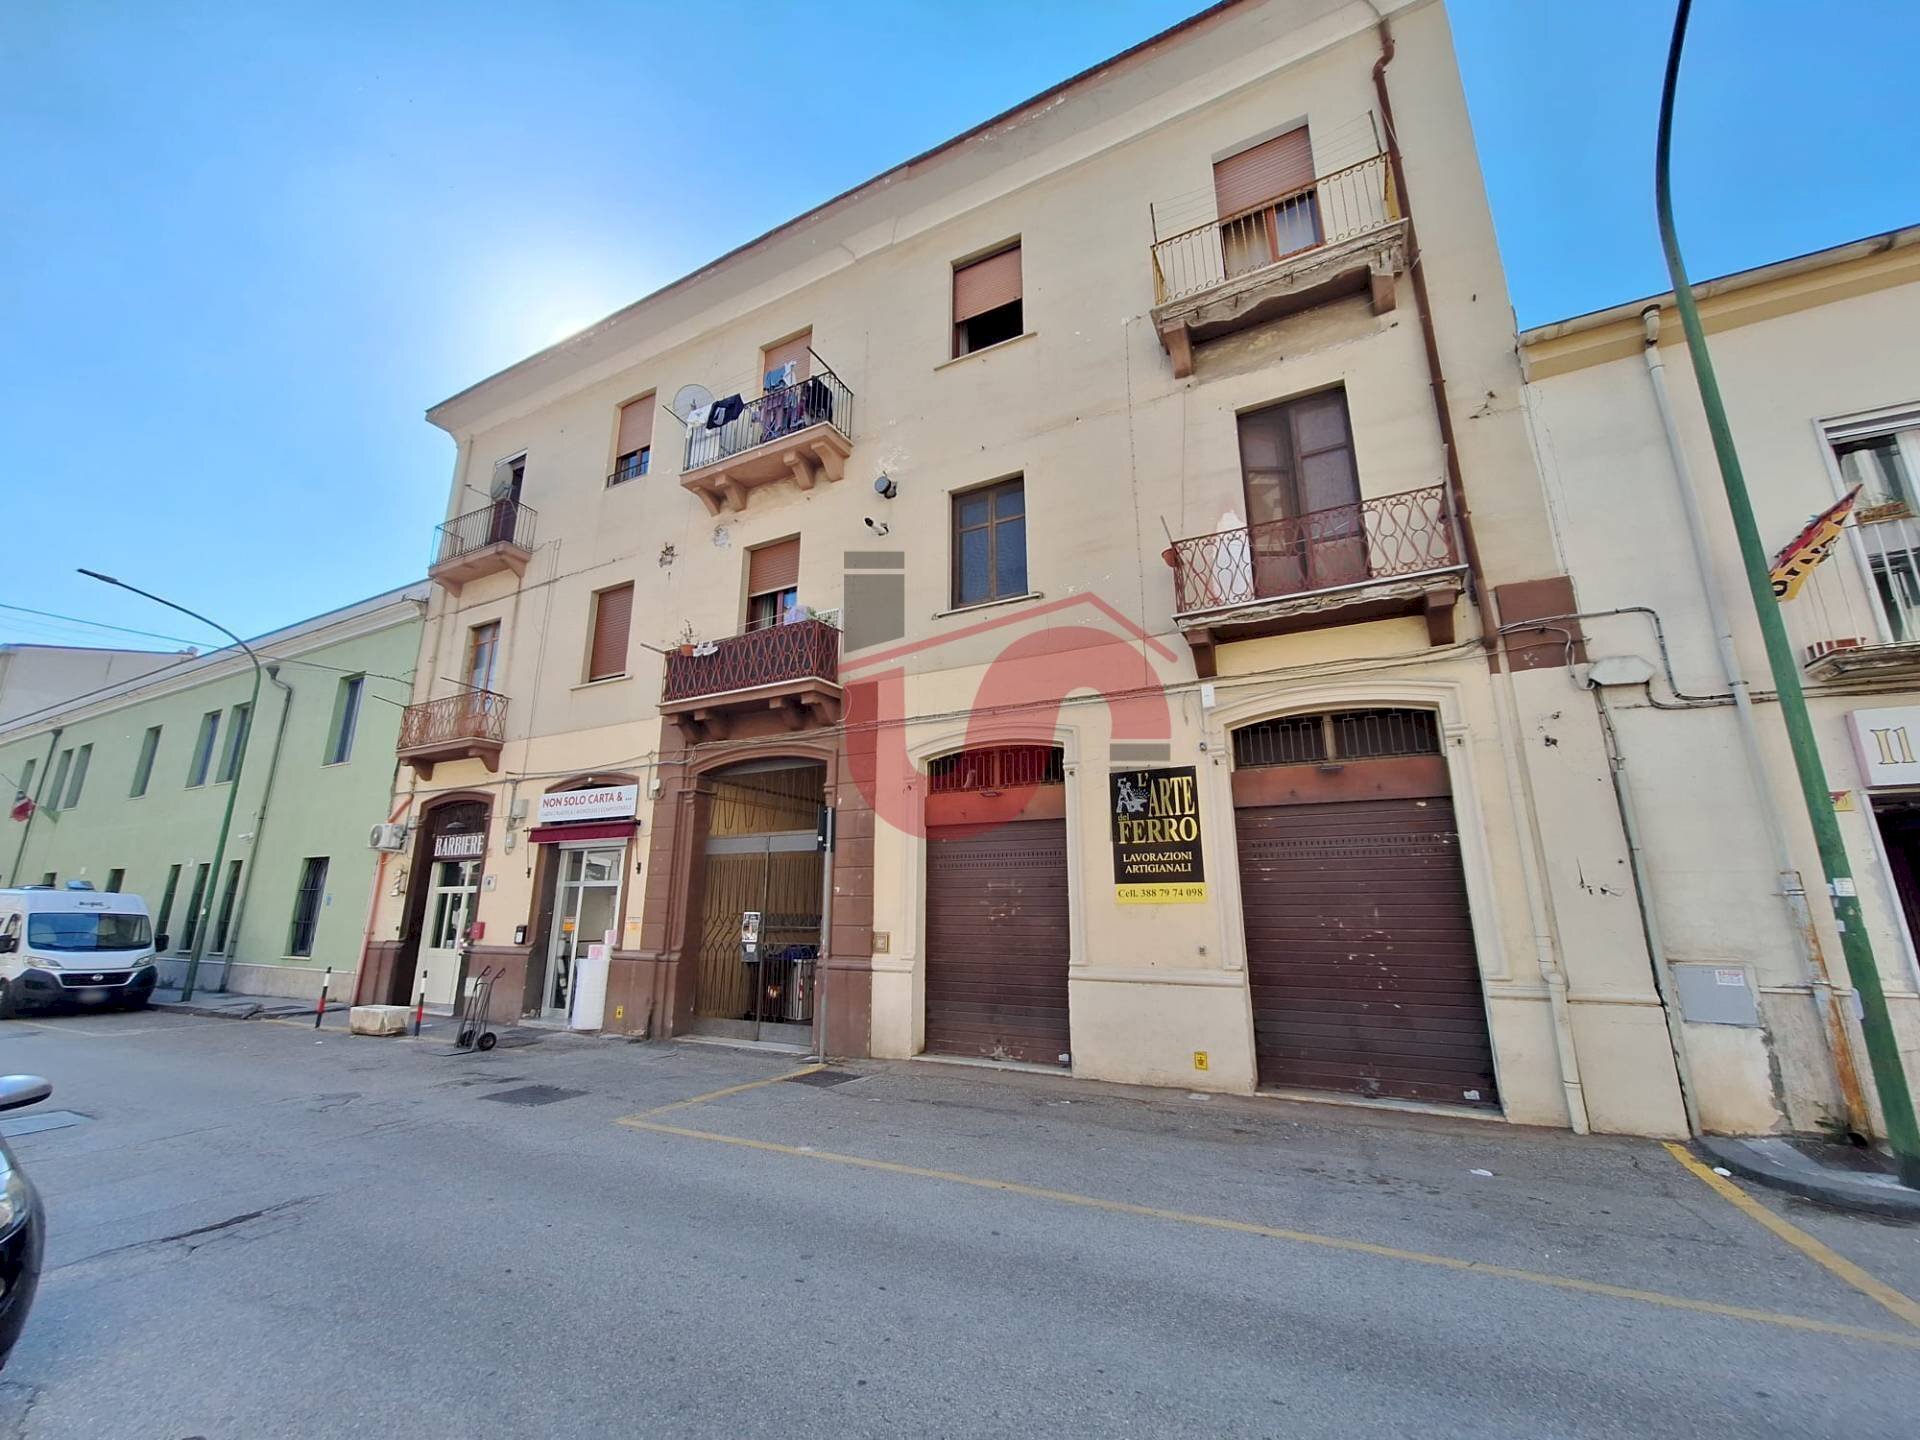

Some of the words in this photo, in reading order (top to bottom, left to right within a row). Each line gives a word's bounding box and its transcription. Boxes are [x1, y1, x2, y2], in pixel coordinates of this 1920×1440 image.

[542, 797, 562, 808] NON
[564, 795, 586, 806] SOLO
[588, 792, 615, 804] CARTA
[616, 792, 623, 802] &
[1118, 813, 1130, 822] del
[1117, 816, 1198, 845] FERRO
[434, 835, 485, 857] BARBIERE
[1123, 851, 1193, 863] LAVORAZIONI
[1125, 863, 1192, 874] ARTIGIANALI
[1118, 888, 1139, 898] Cell.
[1140, 888, 1157, 897] 388
[1159, 888, 1170, 897] 79
[1173, 888, 1184, 897] 74
[1186, 887, 1203, 897] 098
